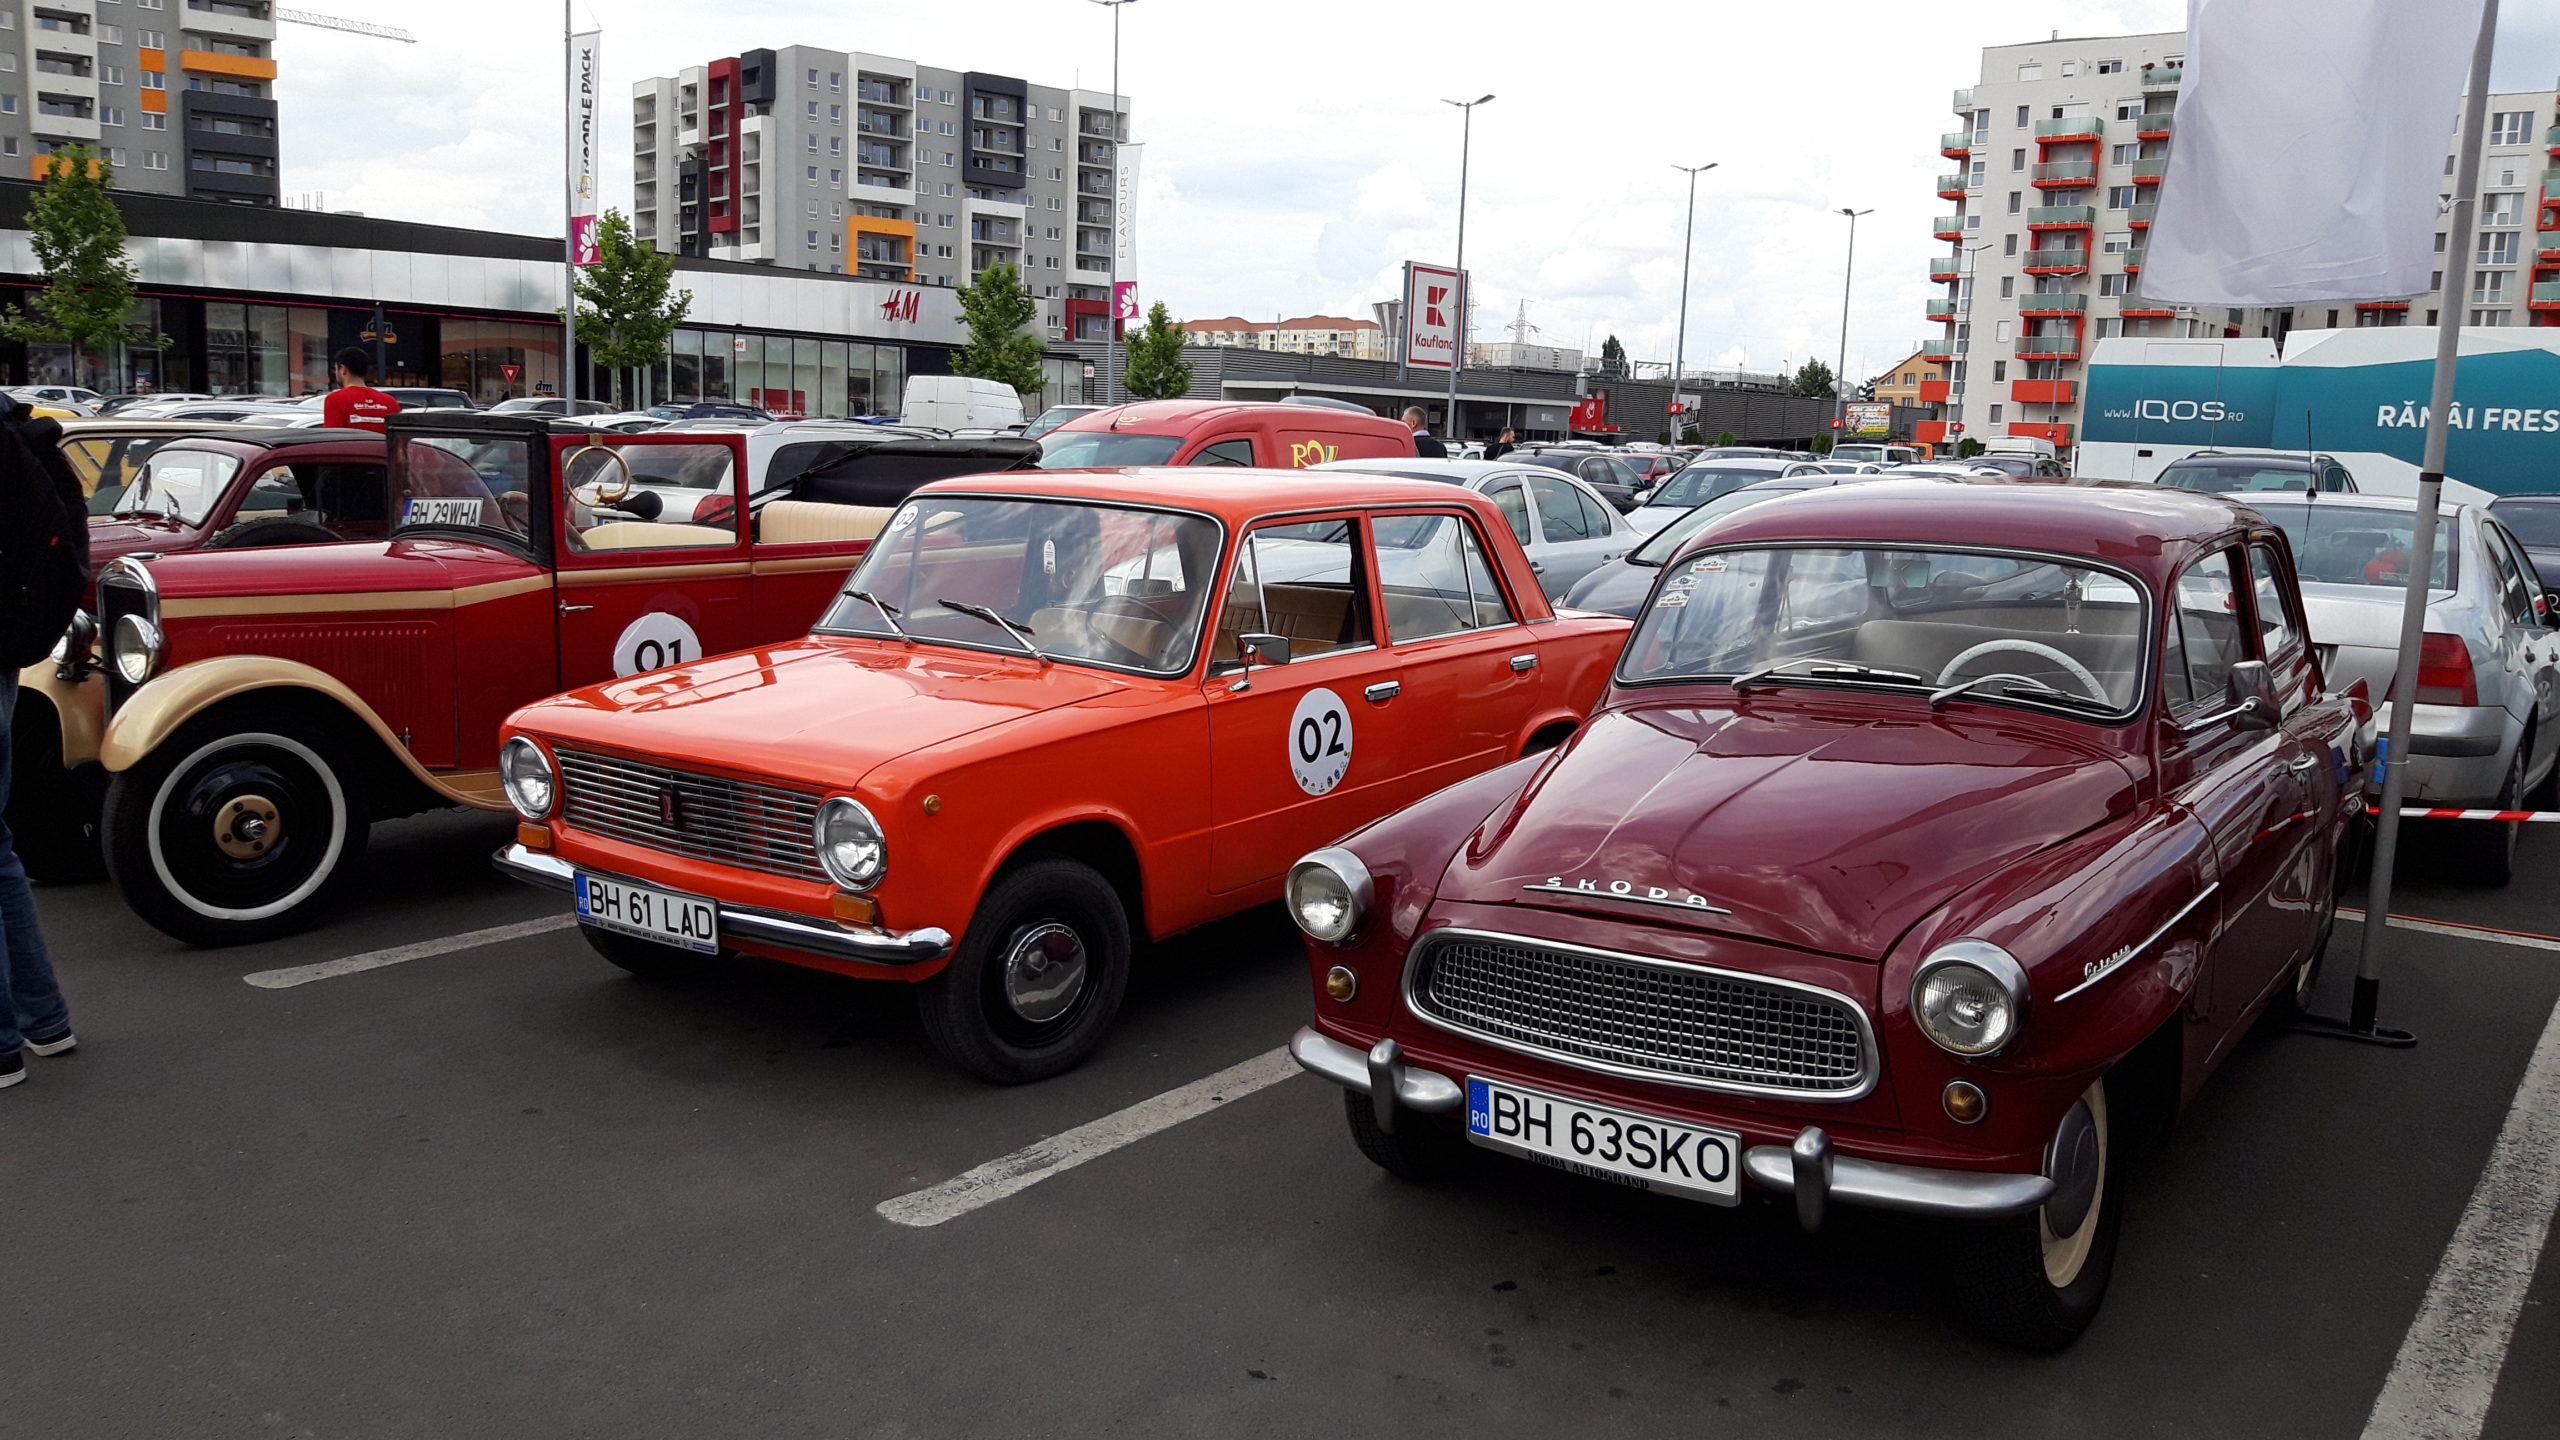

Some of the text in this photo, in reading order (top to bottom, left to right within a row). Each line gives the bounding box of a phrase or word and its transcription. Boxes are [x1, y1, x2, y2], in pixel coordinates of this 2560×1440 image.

[581, 48, 592, 94] PACK
[1118, 166, 1129, 259] FLAVOURS
[881, 289, 921, 324] H&M
[535, 380, 553, 391] dm
[2482, 408, 2560, 433] FRES
[409, 502, 430, 524] BH
[895, 513, 914, 526] 02
[634, 639, 682, 673] 01
[1298, 709, 1344, 764] 02
[589, 880, 621, 919] BH
[629, 891, 652, 928] 61
[663, 898, 713, 940] LAD
[1471, 1109, 1488, 1130] RO
[1493, 1090, 1730, 1183] BH 63SKO
